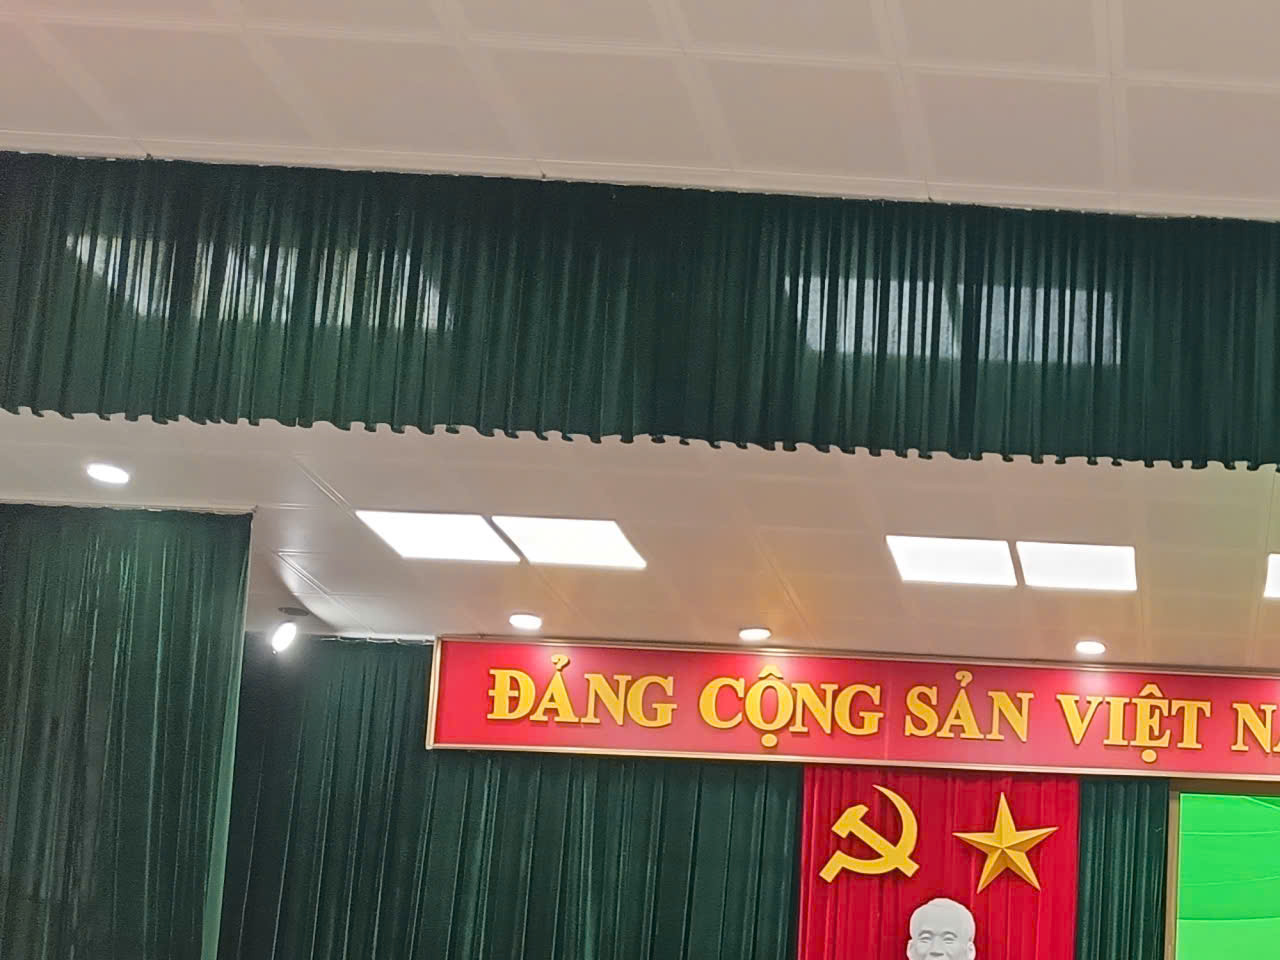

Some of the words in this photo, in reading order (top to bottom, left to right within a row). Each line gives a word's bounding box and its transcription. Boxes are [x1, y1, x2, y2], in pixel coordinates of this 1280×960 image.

[486, 654, 678, 729] ĐẢNG
[699, 664, 884, 748] CỘNG
[904, 670, 1034, 743] SẢN
[1056, 684, 1211, 763] VIỆT
